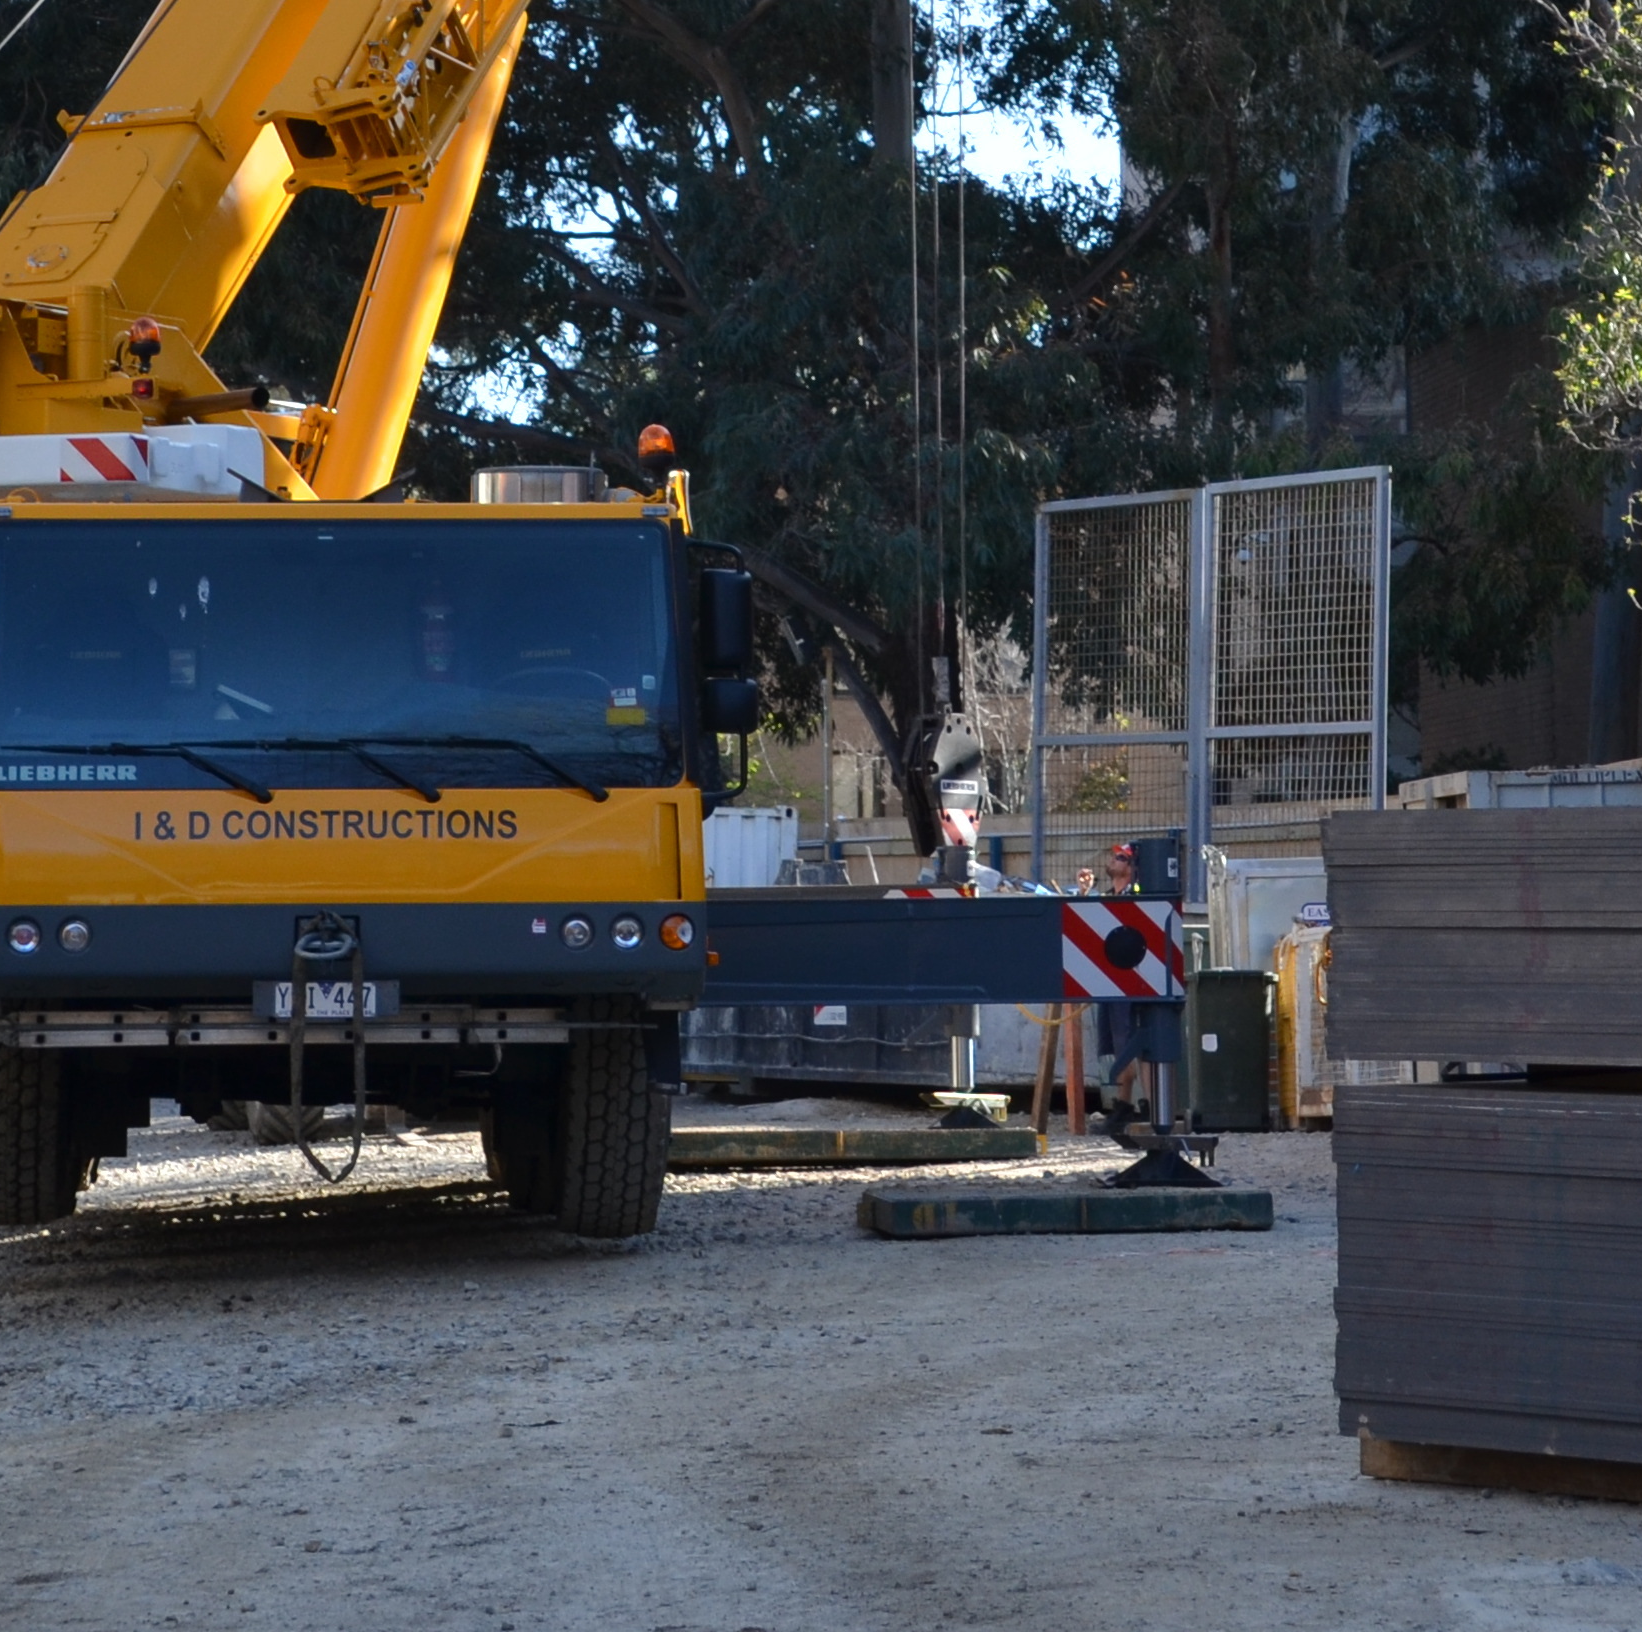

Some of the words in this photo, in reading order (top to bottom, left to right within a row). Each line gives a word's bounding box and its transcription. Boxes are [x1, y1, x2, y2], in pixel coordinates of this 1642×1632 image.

[134, 811, 142, 840] I
[153, 811, 176, 840] &
[188, 811, 211, 840] D
[221, 809, 518, 839] CONSTRUCTIONS
[277, 986, 315, 1009] YI
